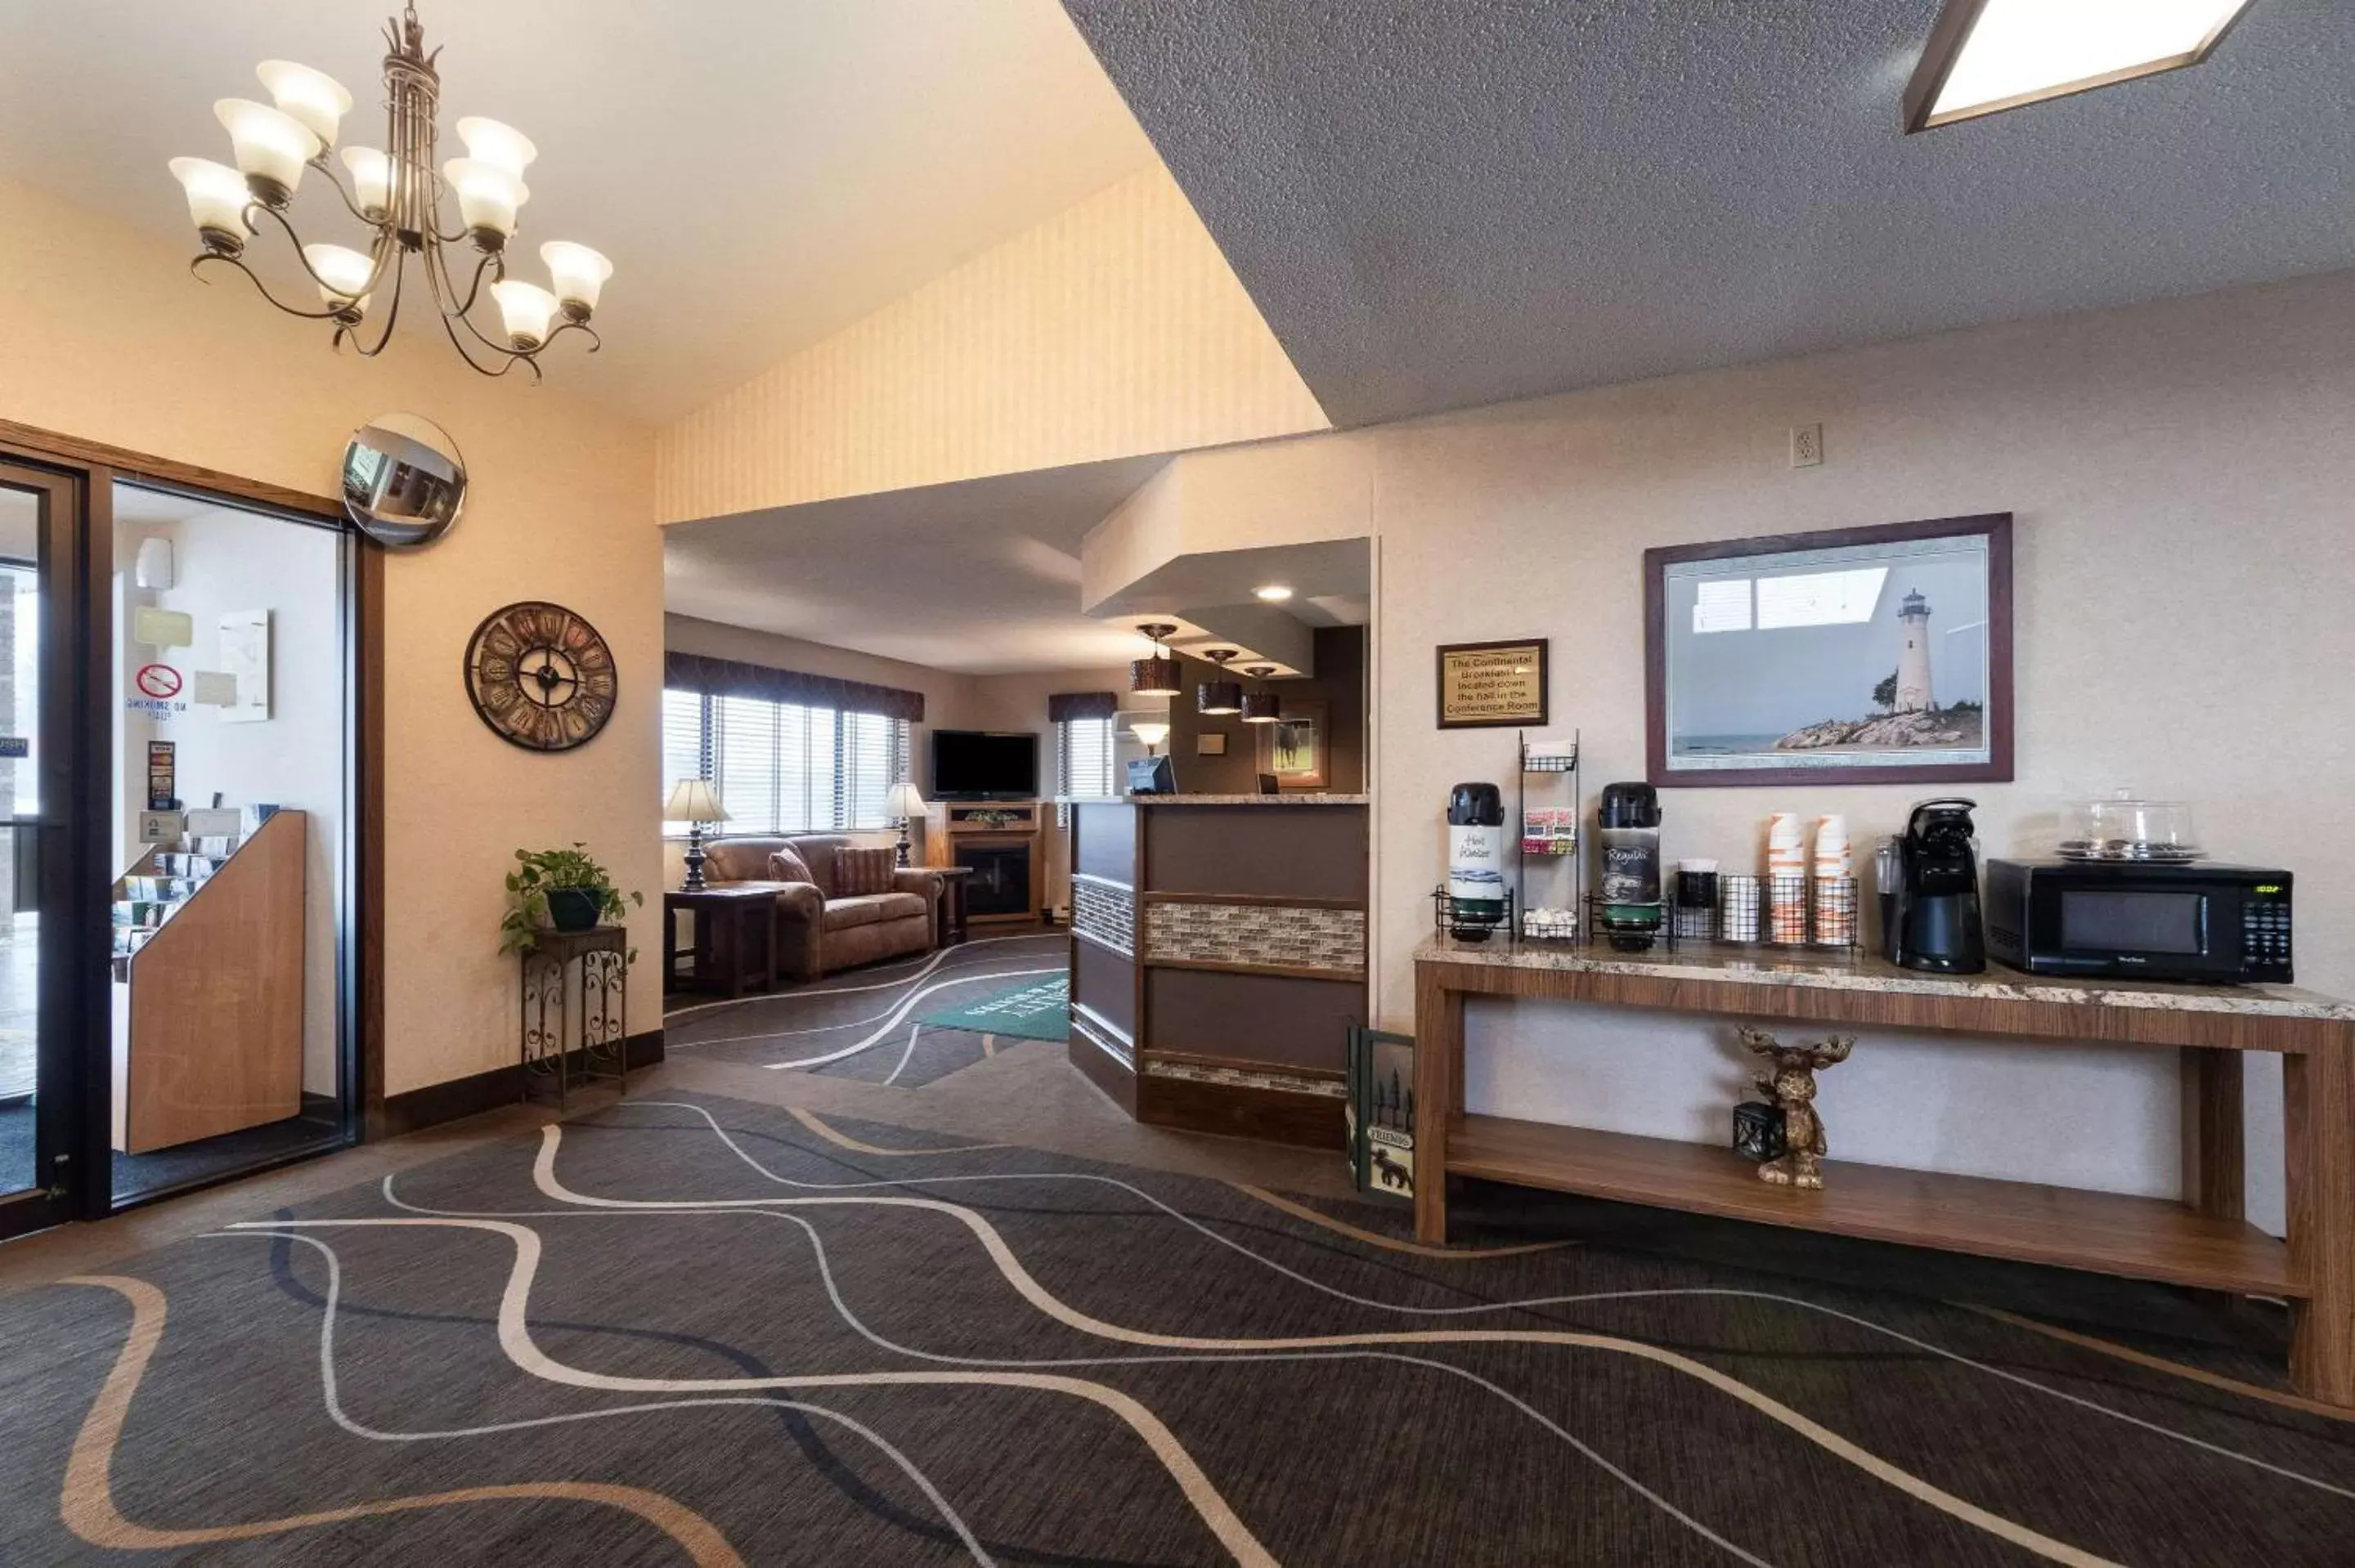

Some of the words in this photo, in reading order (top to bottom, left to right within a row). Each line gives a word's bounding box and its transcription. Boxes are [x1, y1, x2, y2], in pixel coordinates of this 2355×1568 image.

[1451, 659, 1470, 668] The
[1473, 656, 1532, 667] Continental
[1457, 680, 1496, 691] located
[1497, 680, 1526, 688] down
[1457, 692, 1474, 701] the
[1497, 690, 1507, 700] in
[1509, 690, 1527, 700] the
[1446, 703, 1505, 714] Conference
[1507, 701, 1539, 710] Room
[1607, 848, 1648, 866] Regular
[1369, 1129, 1411, 1147] FRIENDS
